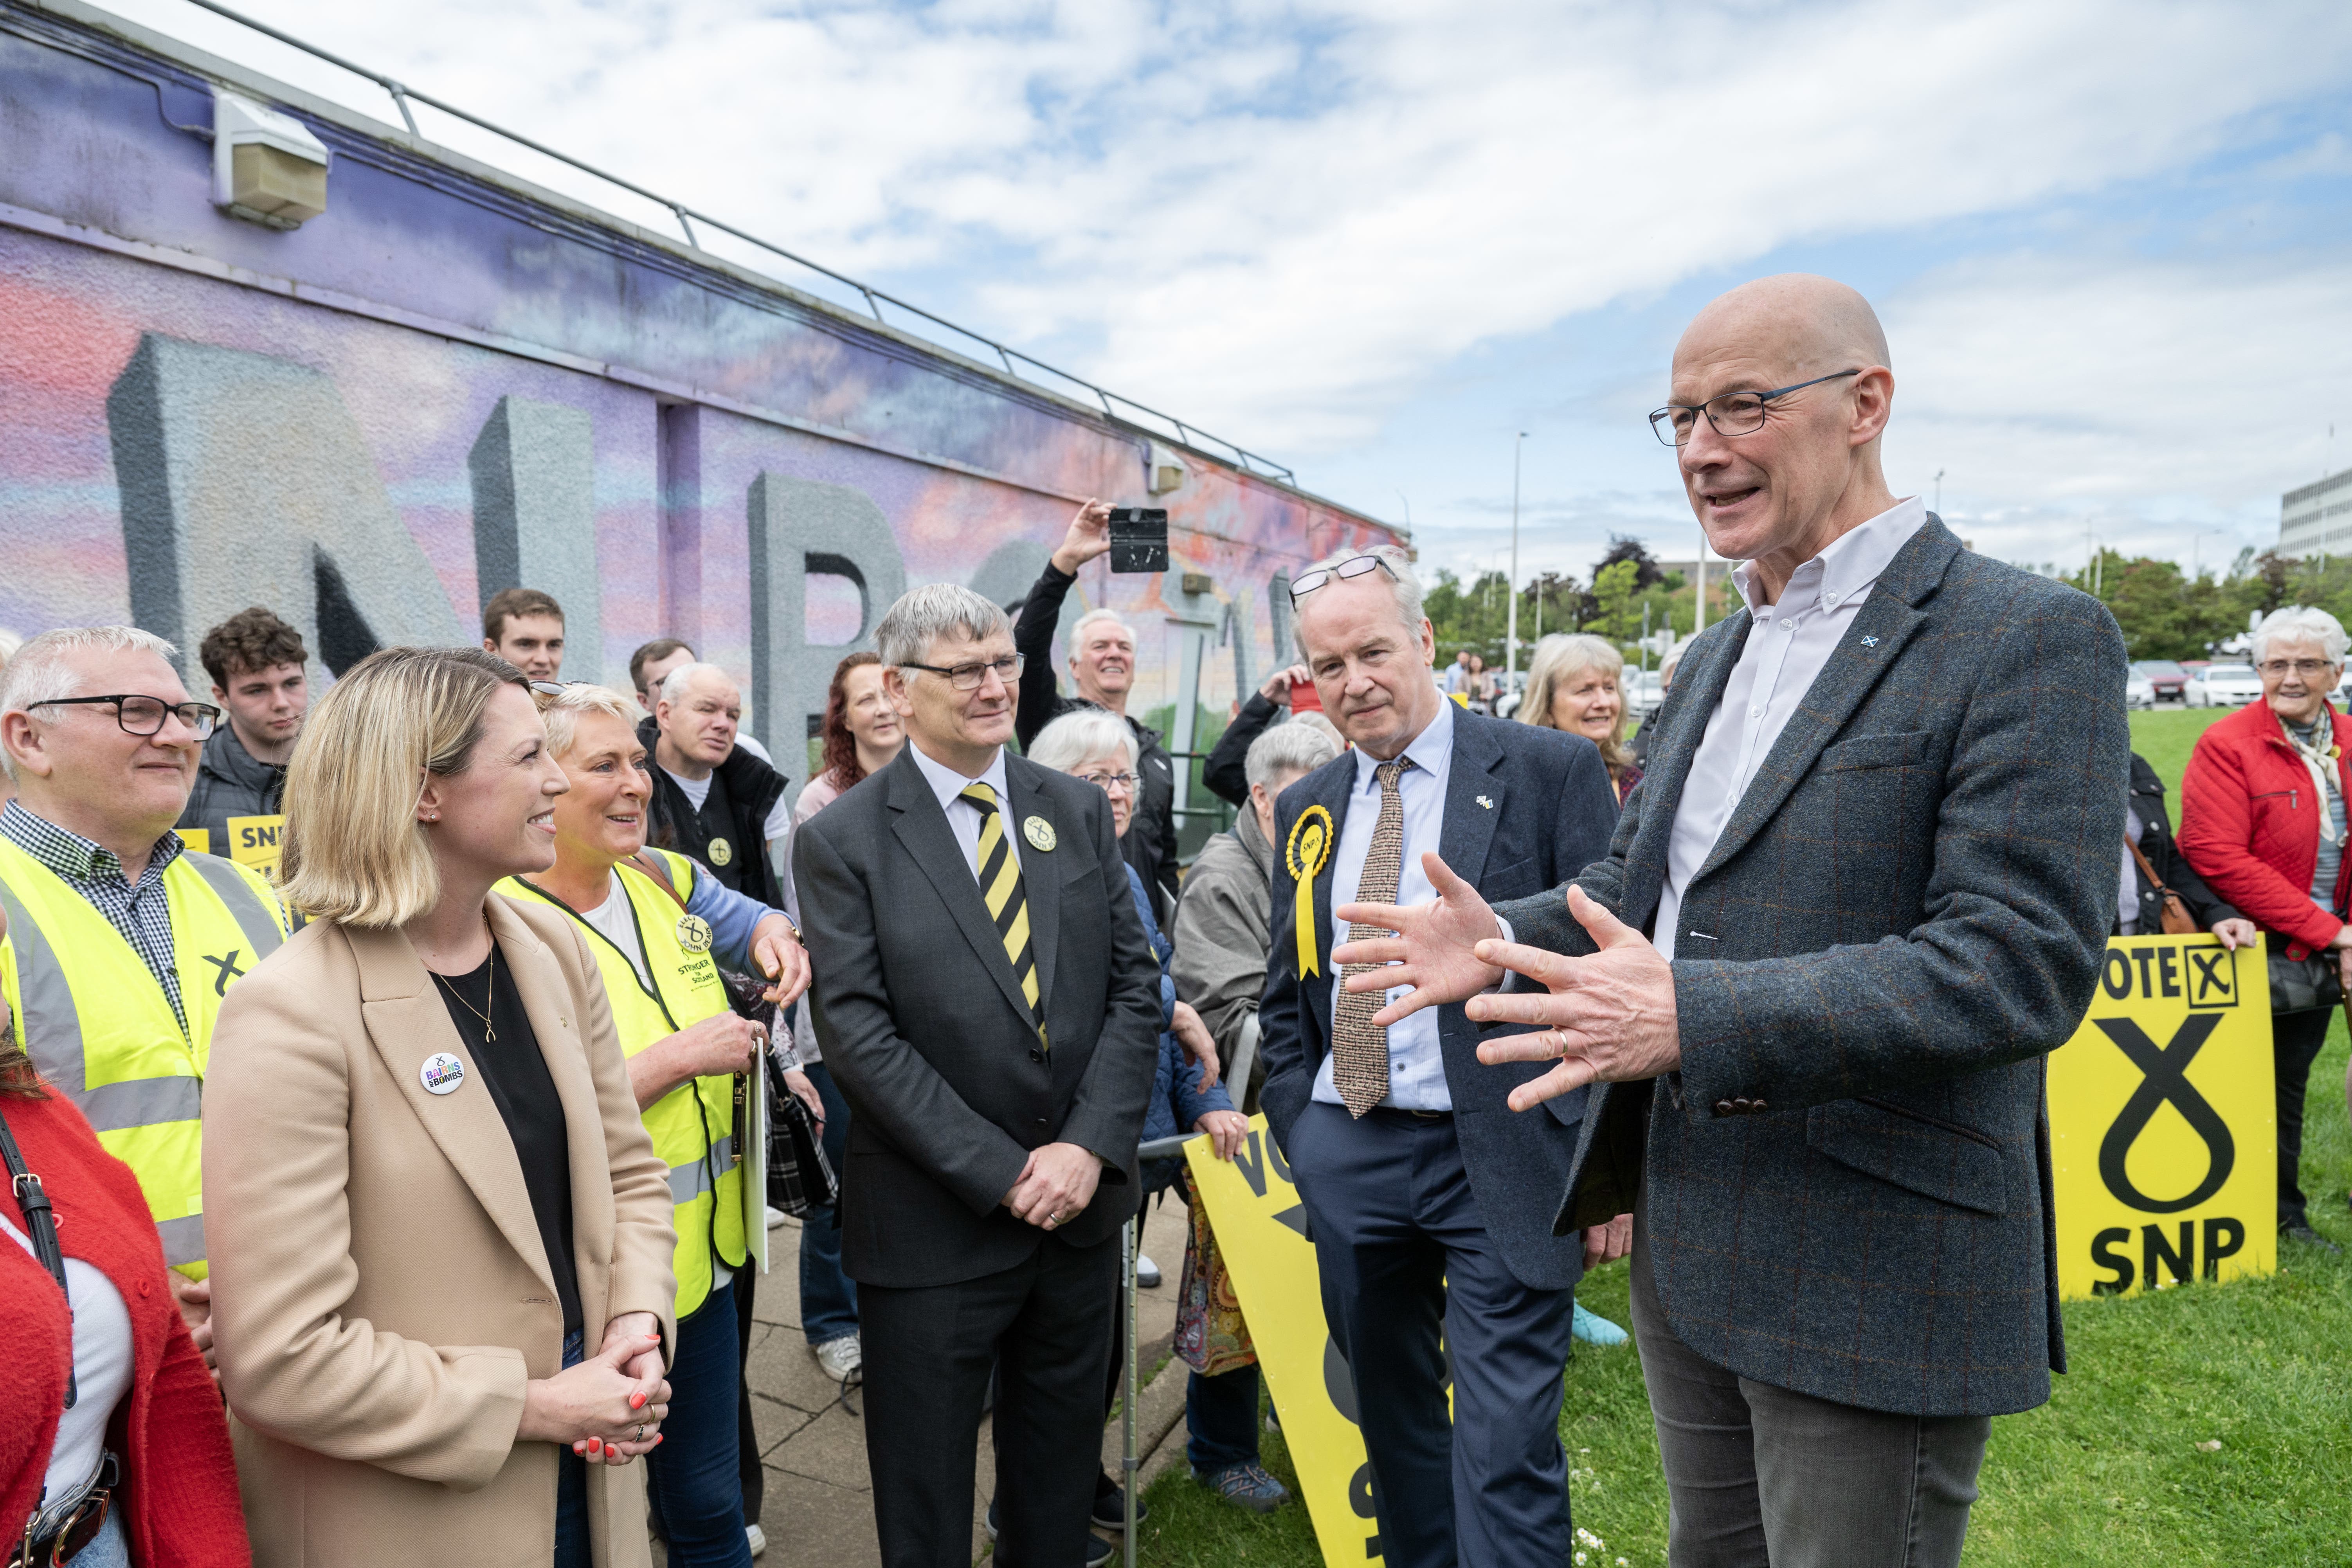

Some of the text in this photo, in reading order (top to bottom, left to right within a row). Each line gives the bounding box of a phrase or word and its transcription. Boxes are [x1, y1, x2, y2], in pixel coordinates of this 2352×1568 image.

[1303, 839, 1315, 853] SNP
[678, 916, 695, 928] ELECT
[681, 938, 702, 951] JOHN
[2102, 947, 2181, 1000] OTE
[426, 1062, 460, 1080] BAIRNS
[433, 1070, 463, 1086] BOMBS
[2091, 1217, 2245, 1297] SNP
